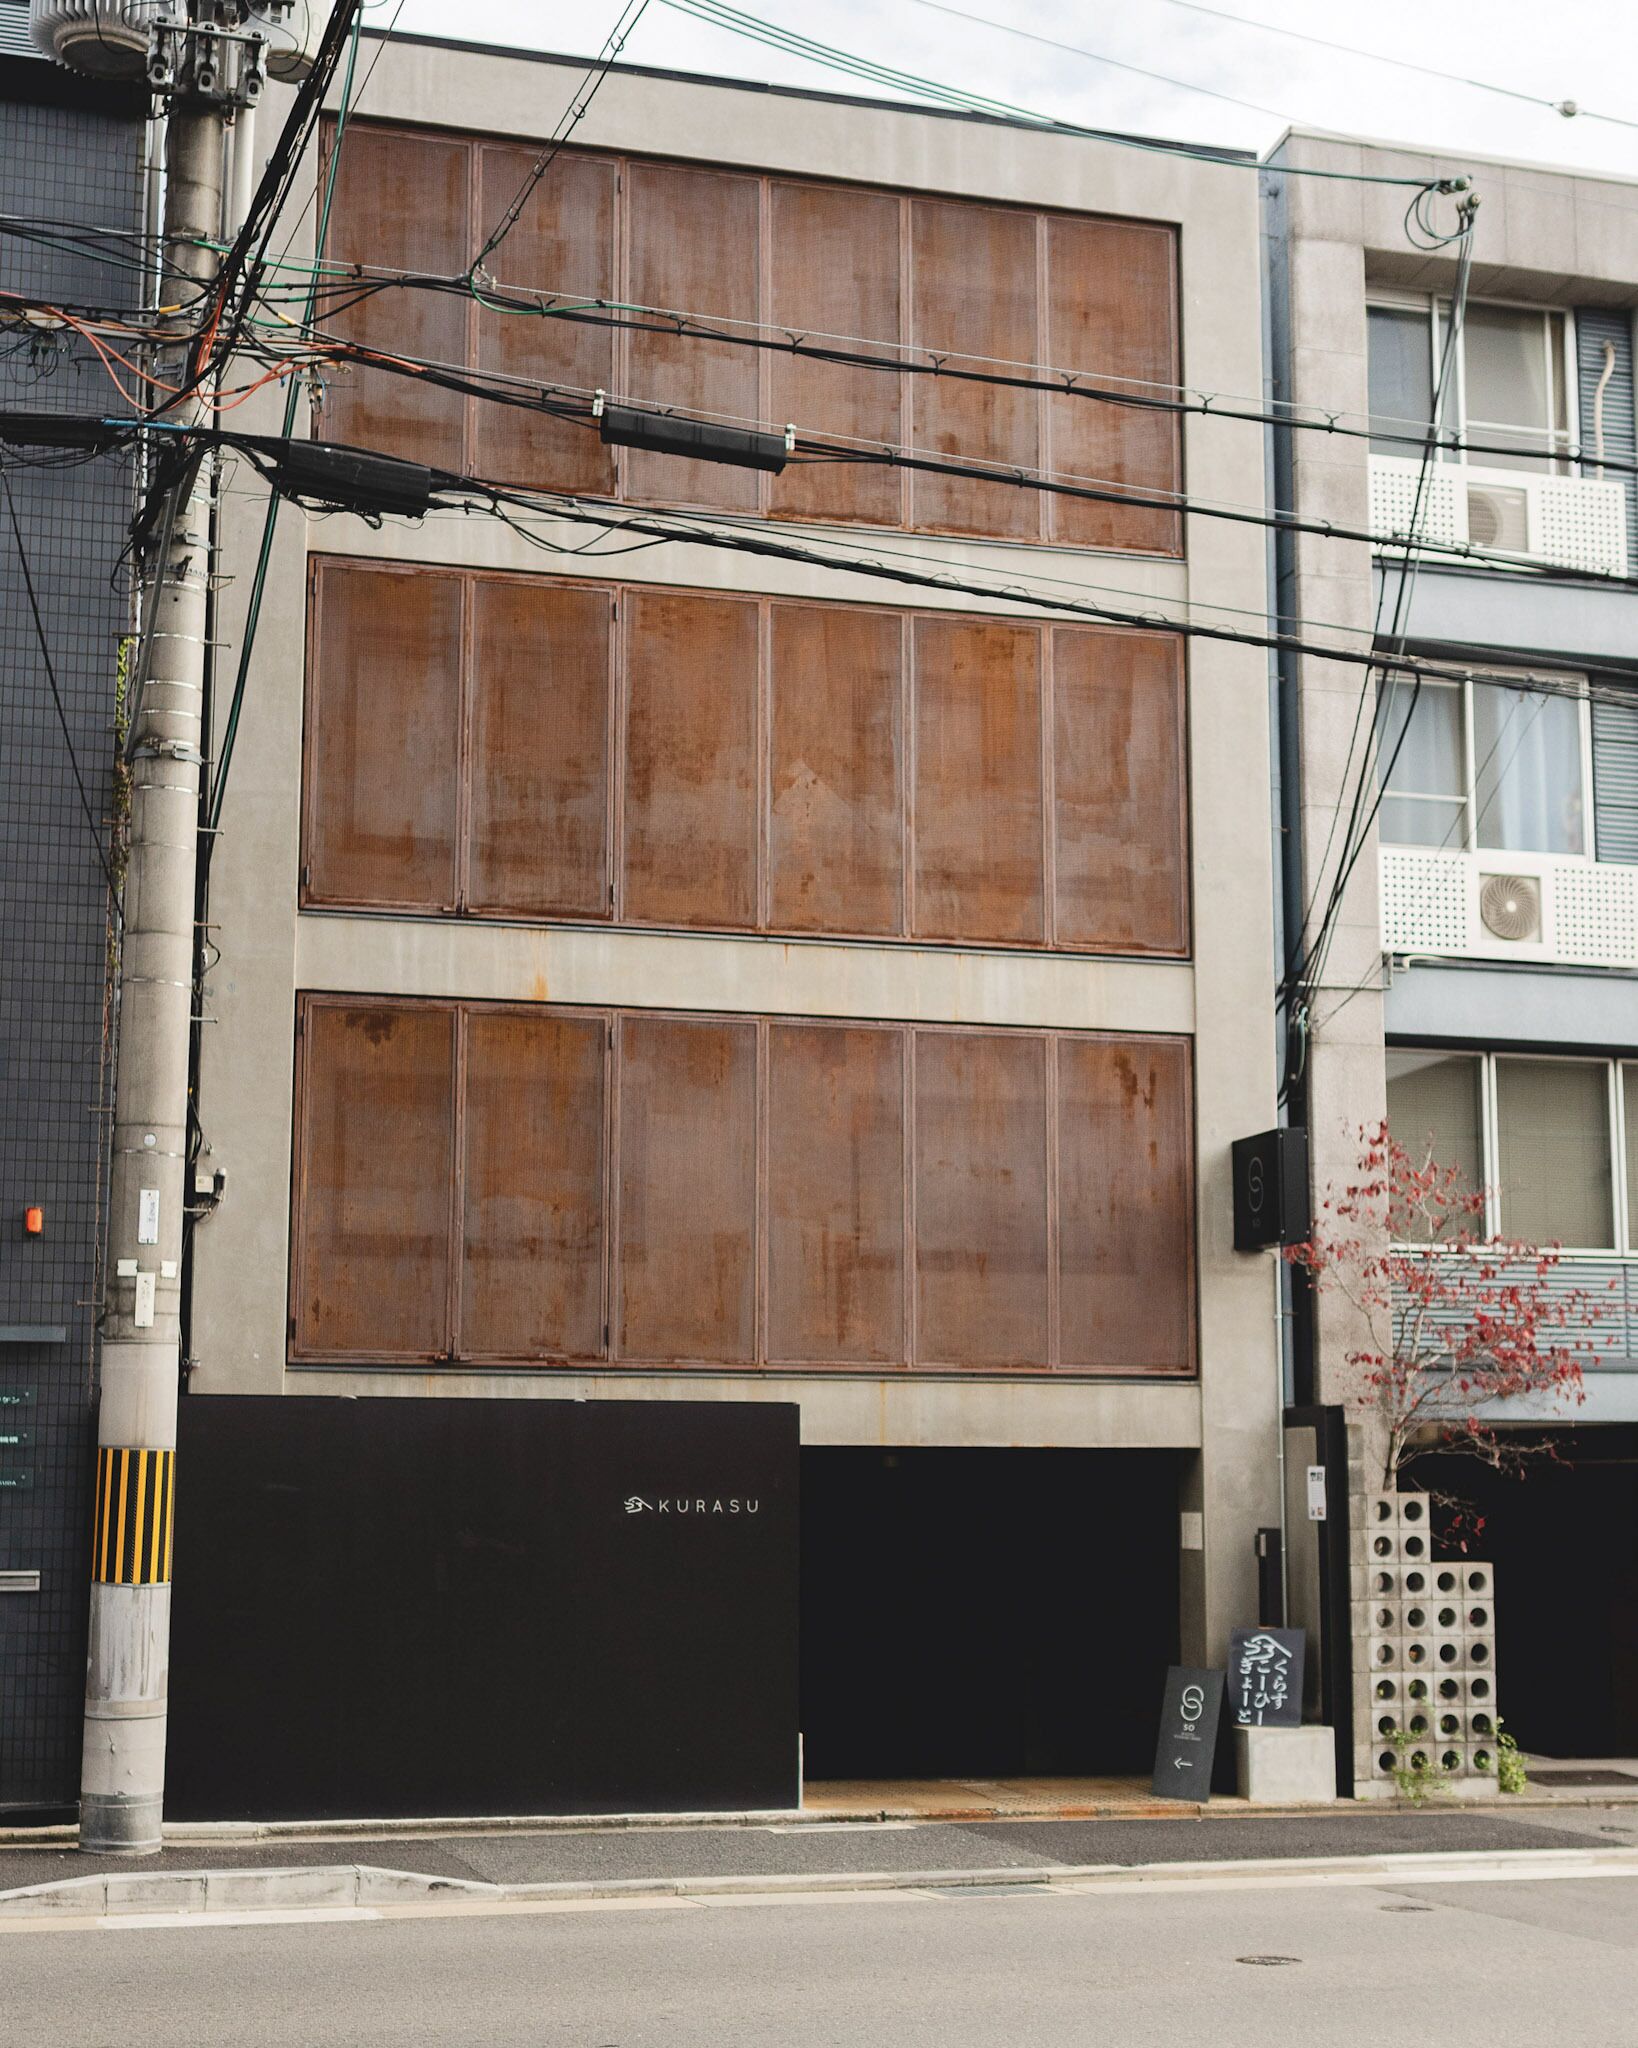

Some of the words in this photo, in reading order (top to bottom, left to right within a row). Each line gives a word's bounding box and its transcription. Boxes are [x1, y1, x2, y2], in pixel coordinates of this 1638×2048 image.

[658, 1499, 759, 1513] KURASU
[1253, 1660, 1271, 1726] こーひー
[1270, 1659, 1289, 1710] くらす
[1182, 1723, 1196, 1732] SO
